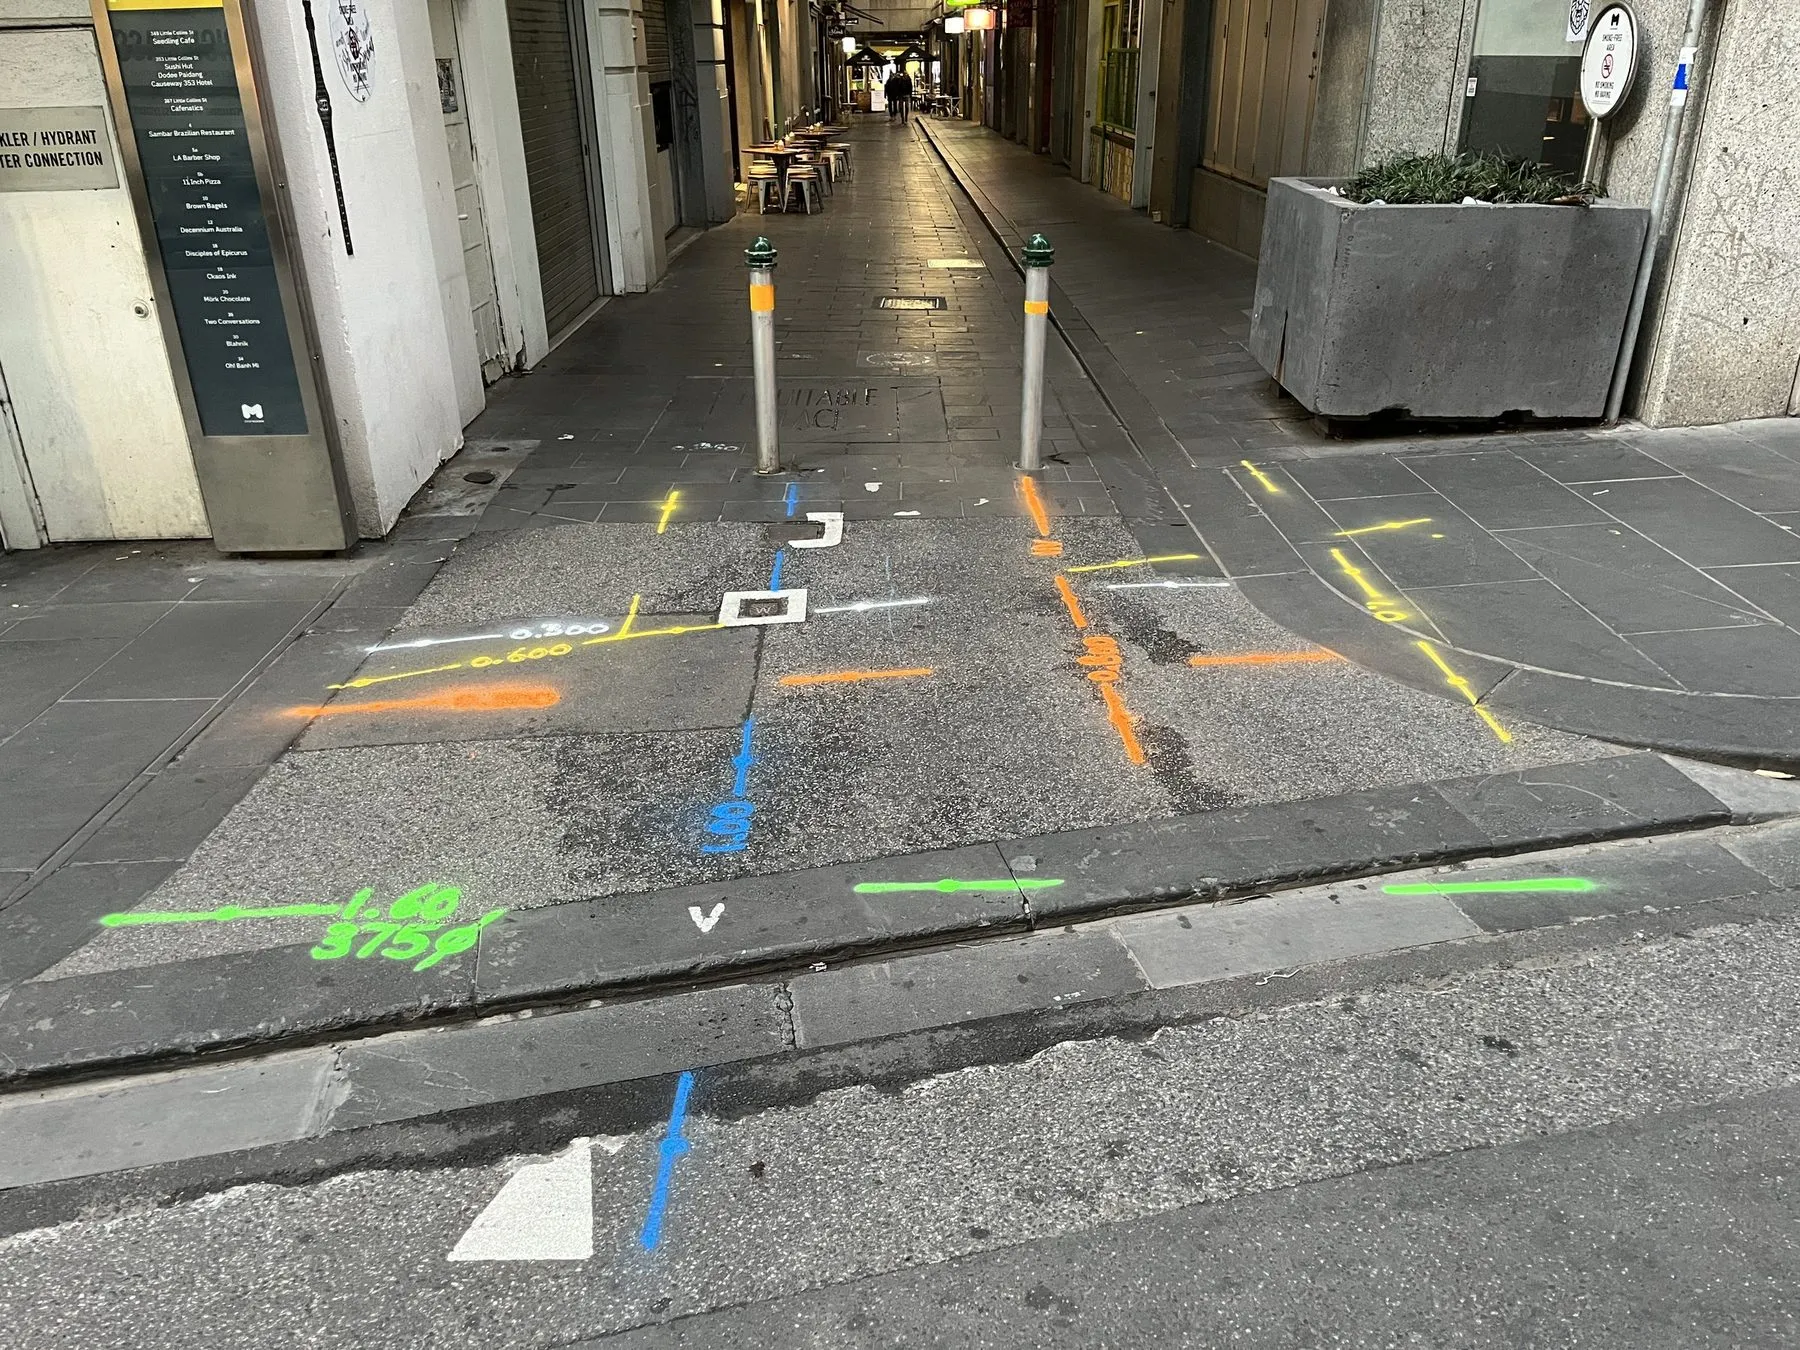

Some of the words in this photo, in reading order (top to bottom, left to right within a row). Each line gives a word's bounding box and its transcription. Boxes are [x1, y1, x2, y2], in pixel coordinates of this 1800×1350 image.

[152, 37, 180, 46] Seedling
[179, 36, 195, 44] Cafe
[150, 80, 183, 88] Causeway
[170, 104, 204, 112] Cafenatics
[40, 130, 97, 146] HYDRANT
[148, 130, 173, 138] Sambar
[24, 151, 104, 168] CONNECTION
[172, 154, 183, 162] LA
[204, 153, 221, 162] Shop
[185, 202, 207, 210] Brown
[206, 202, 228, 210] Bagels
[180, 226, 215, 234] Decennium
[213, 249, 221, 257] of
[220, 249, 248, 257] Epicurus
[755, 606, 771, 614] W
[509, 622, 610, 640] 0.300
[469, 643, 573, 669] 0.600
